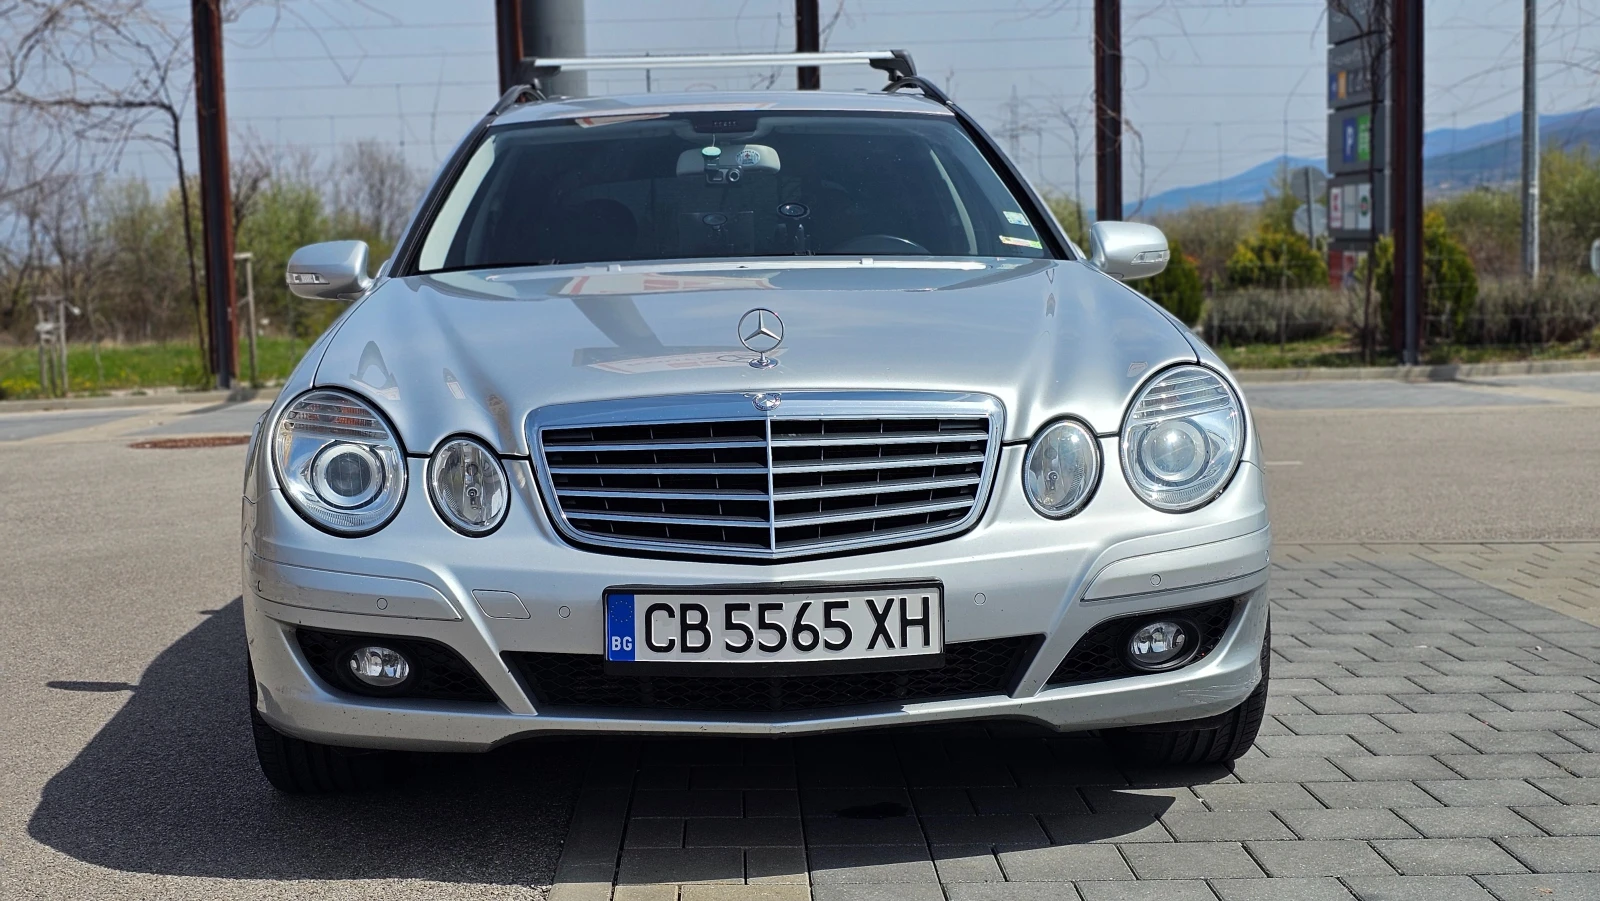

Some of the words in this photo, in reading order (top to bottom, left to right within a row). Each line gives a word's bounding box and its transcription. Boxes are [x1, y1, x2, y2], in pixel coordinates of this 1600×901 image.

[644, 602, 712, 653] CB
[724, 599, 853, 653] 5565
[866, 596, 931, 650] XH
[611, 635, 633, 651] BG
